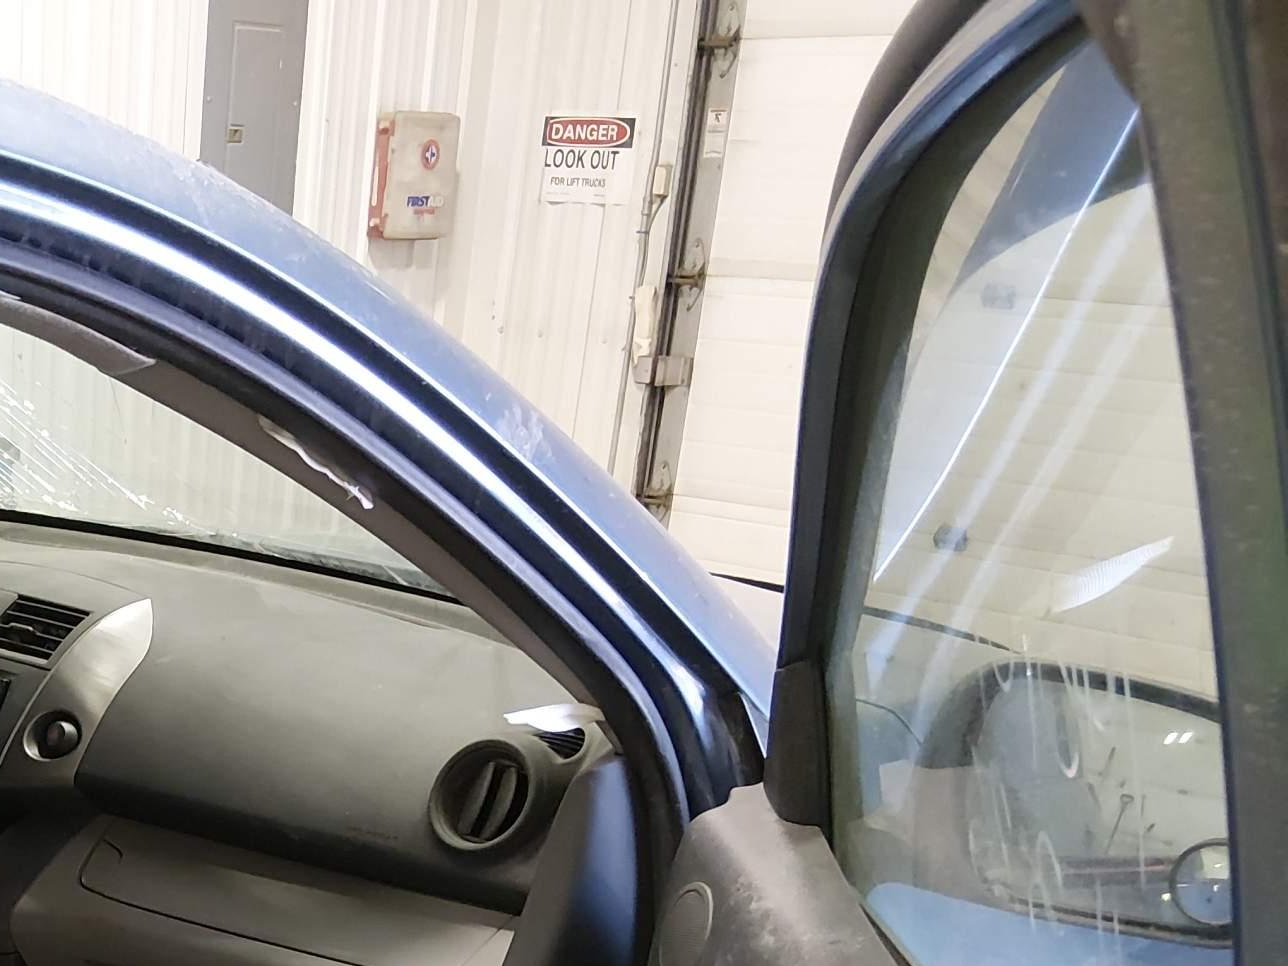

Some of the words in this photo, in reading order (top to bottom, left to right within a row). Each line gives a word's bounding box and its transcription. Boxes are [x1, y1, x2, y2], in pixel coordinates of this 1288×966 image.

[551, 123, 618, 141] DANGER
[544, 148, 587, 168] LOOK
[590, 149, 620, 170] OUT
[550, 176, 565, 187] FOR
[566, 177, 580, 187] LIFT
[406, 195, 431, 208] FIRST
